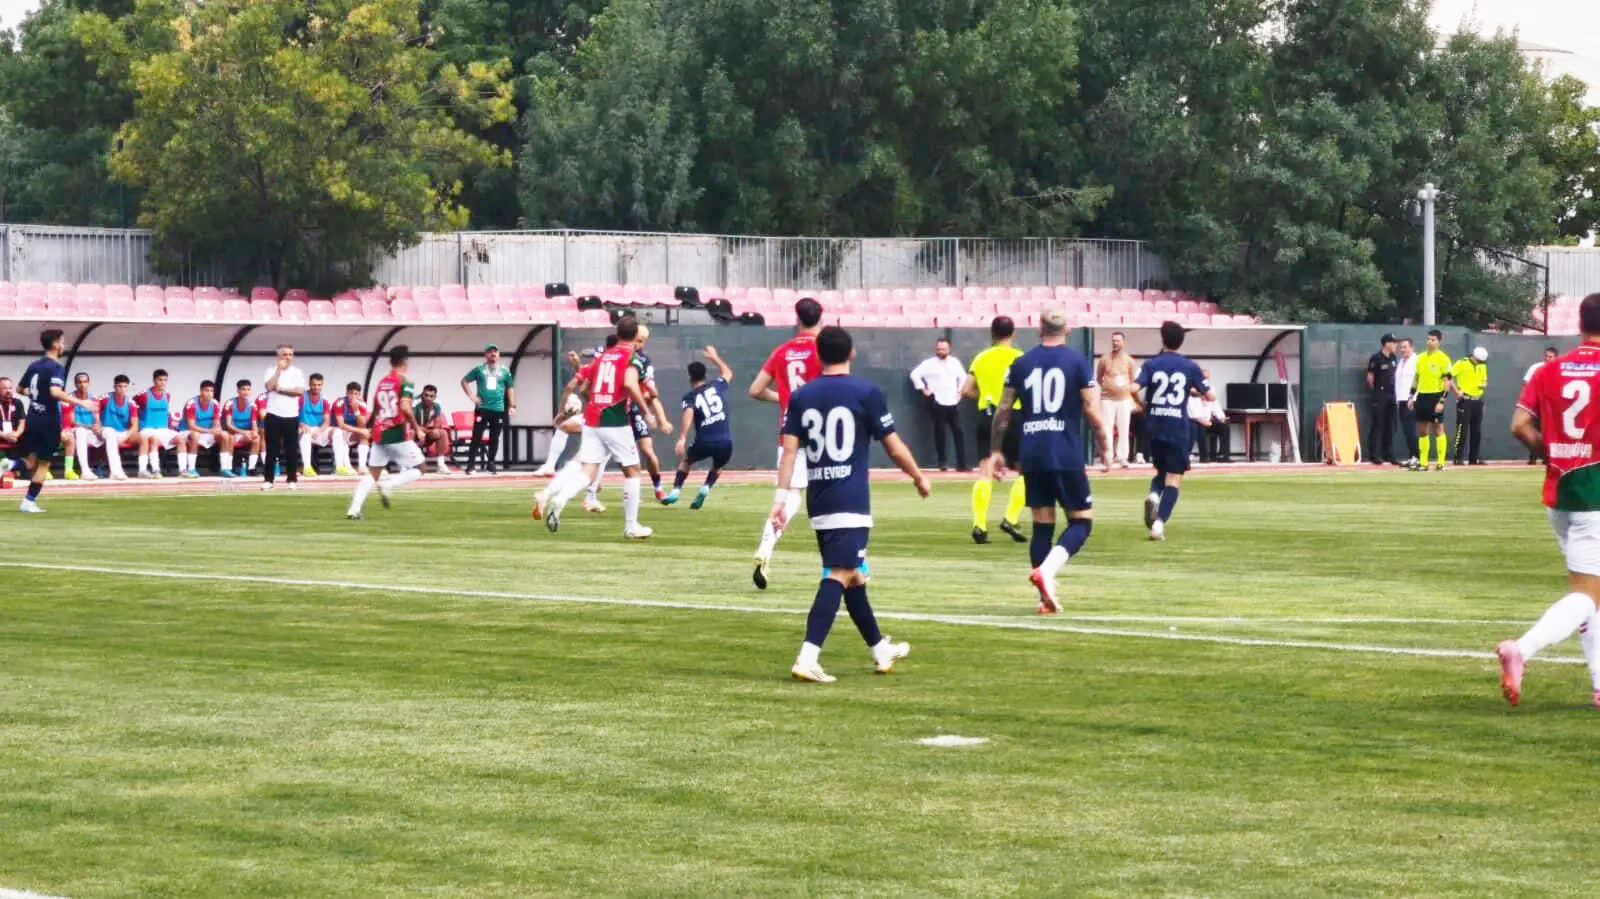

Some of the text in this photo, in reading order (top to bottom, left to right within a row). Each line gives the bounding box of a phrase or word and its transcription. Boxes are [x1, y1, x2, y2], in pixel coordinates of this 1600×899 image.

[30, 373, 40, 401] 4
[594, 361, 616, 393] 14
[1024, 367, 1066, 414] 10
[1151, 371, 1187, 405] 23
[695, 387, 723, 418] 15
[1562, 380, 1591, 440] 2
[801, 406, 856, 463] 30
[823, 465, 852, 481] EVREN
